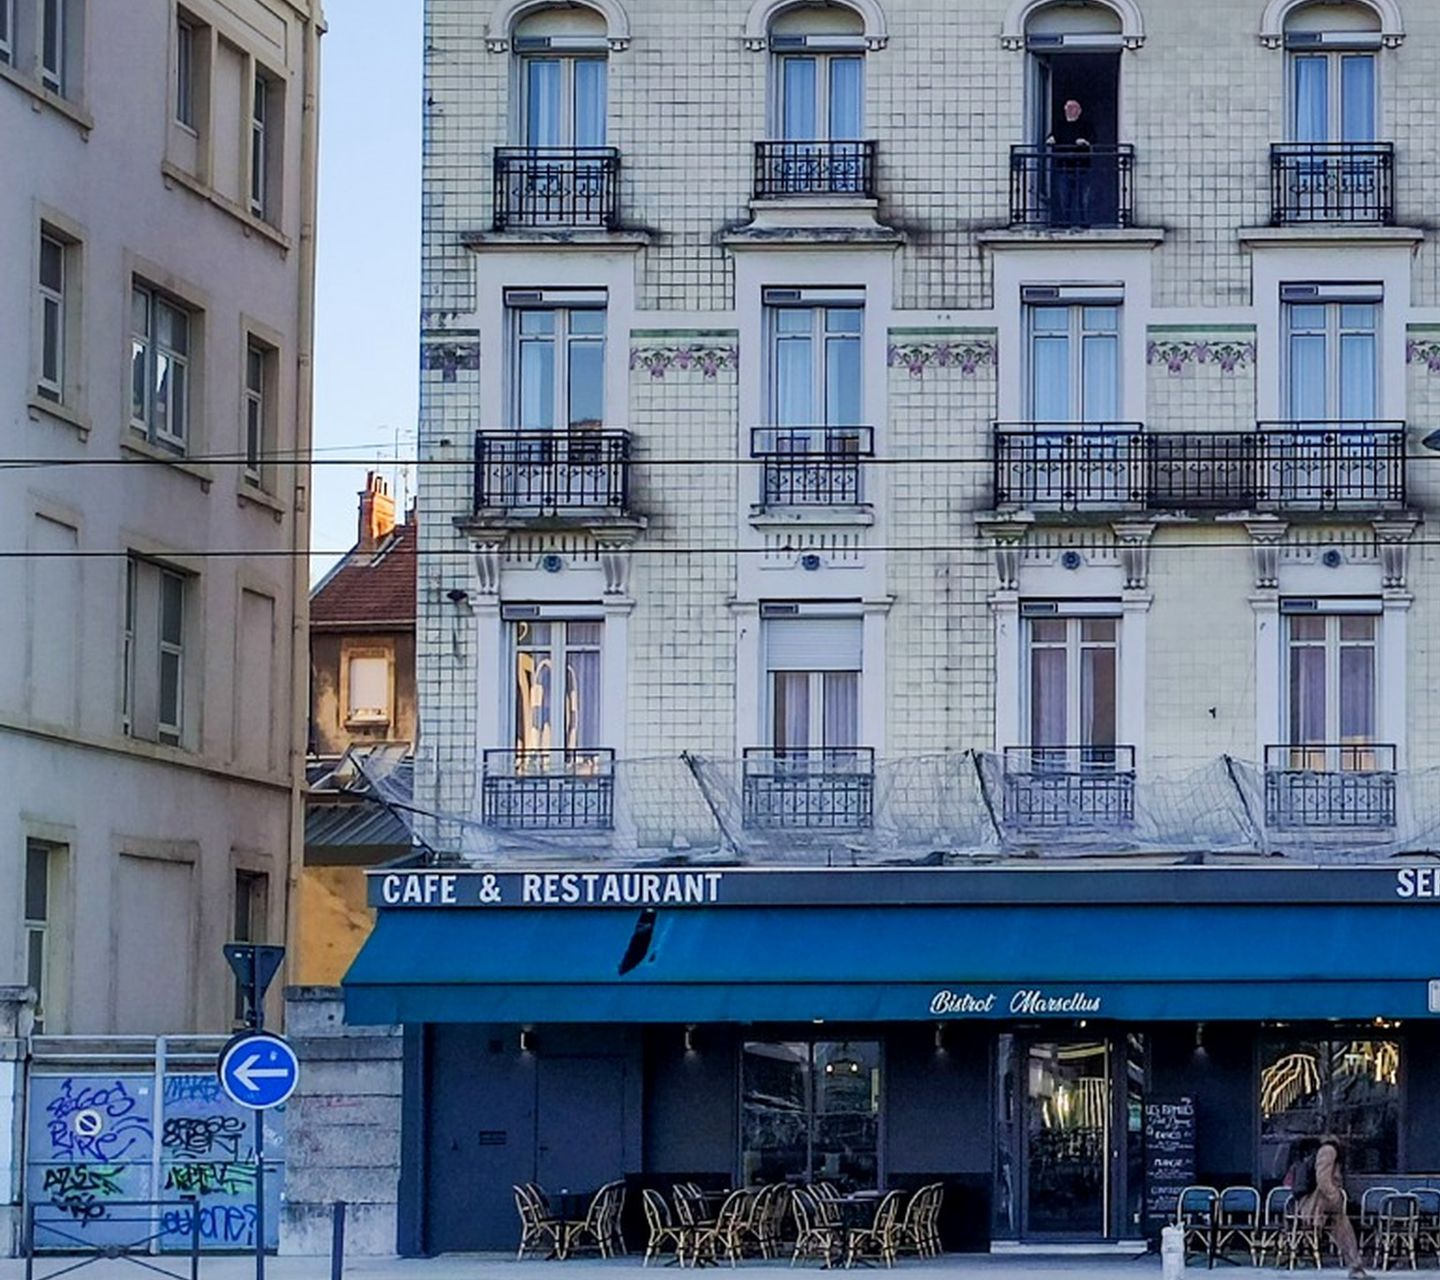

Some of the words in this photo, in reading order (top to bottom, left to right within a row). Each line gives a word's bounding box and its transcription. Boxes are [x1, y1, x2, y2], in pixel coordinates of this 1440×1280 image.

[382, 873, 457, 903] CAFE
[479, 873, 502, 903] &
[522, 873, 723, 903] RESTAURANT
[929, 989, 998, 1014] Bistrot
[1009, 989, 1101, 1014] Marsellus
